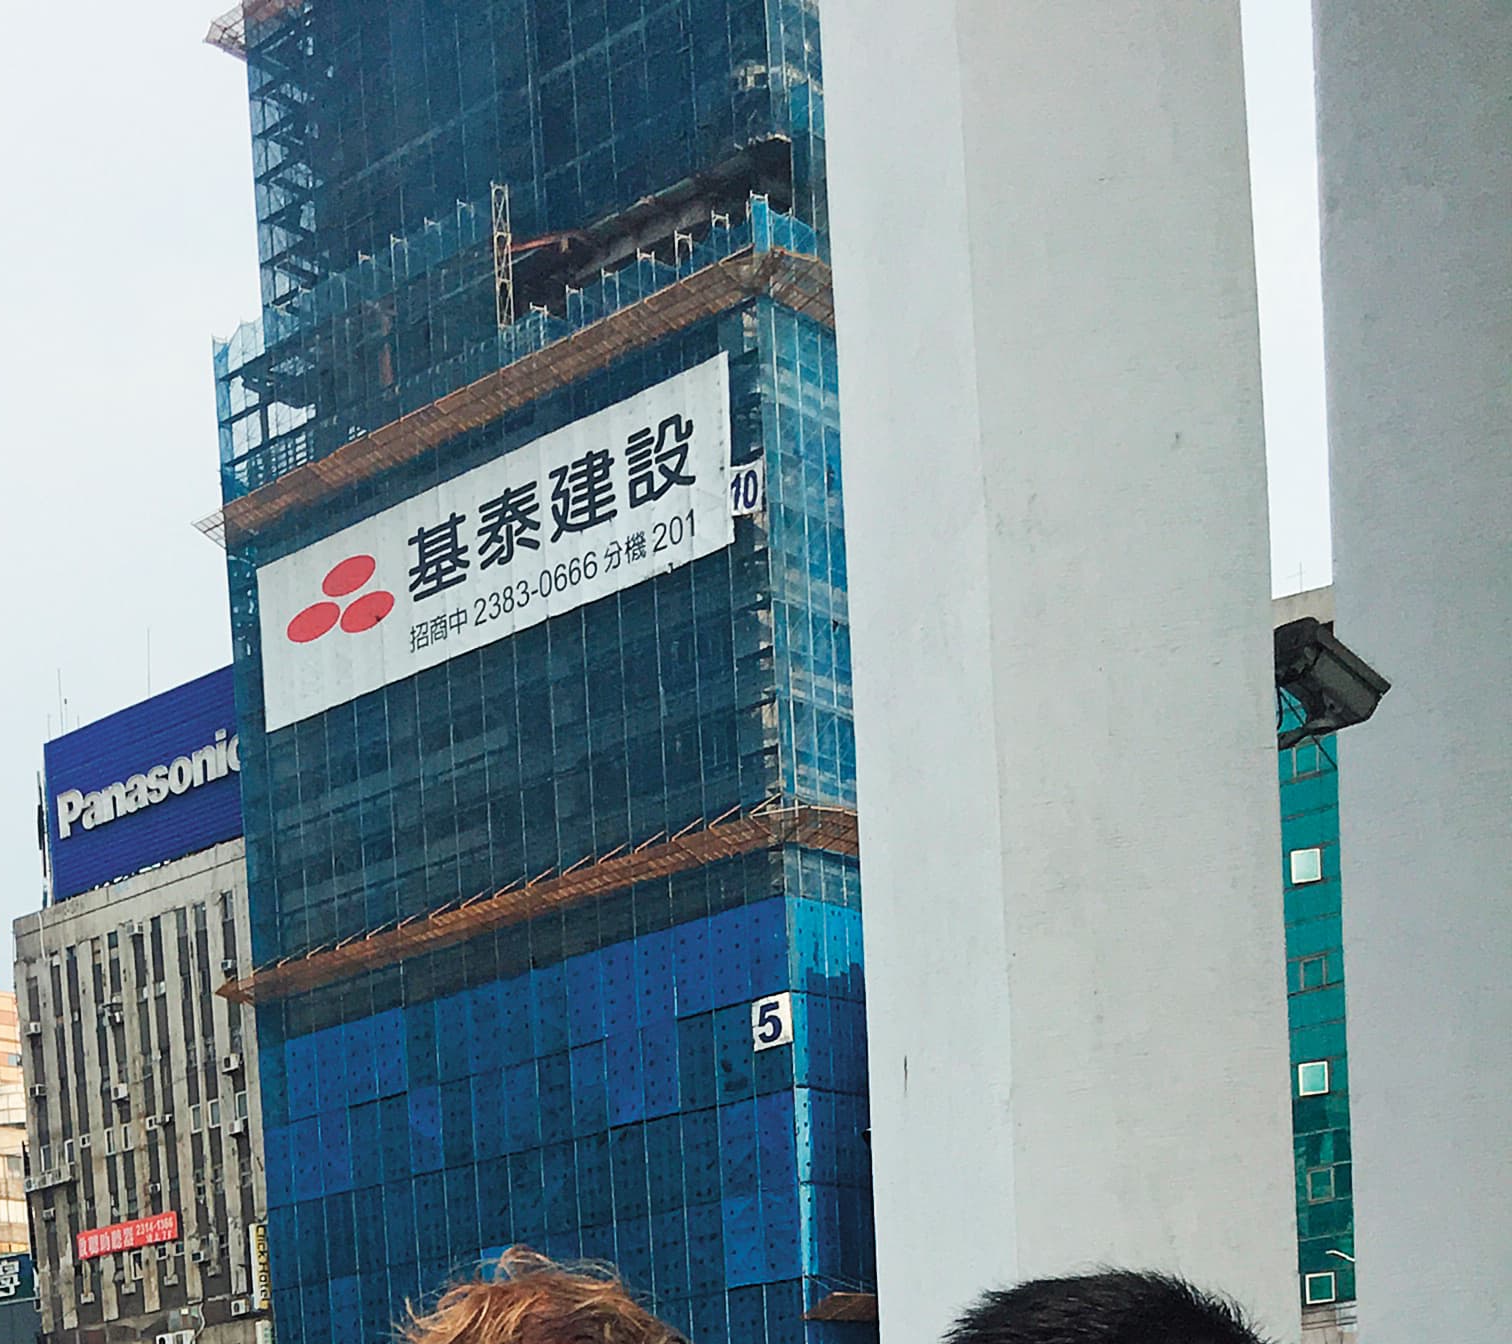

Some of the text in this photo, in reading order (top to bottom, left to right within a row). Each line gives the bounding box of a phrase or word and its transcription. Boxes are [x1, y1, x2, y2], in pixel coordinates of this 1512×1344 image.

[408, 414, 696, 602] 基泰建設
[731, 470, 758, 510] 10
[410, 509, 696, 653] 招商中 2383-0666 分機 201
[56, 728, 240, 840] Panasonic
[758, 1001, 782, 1043] 5
